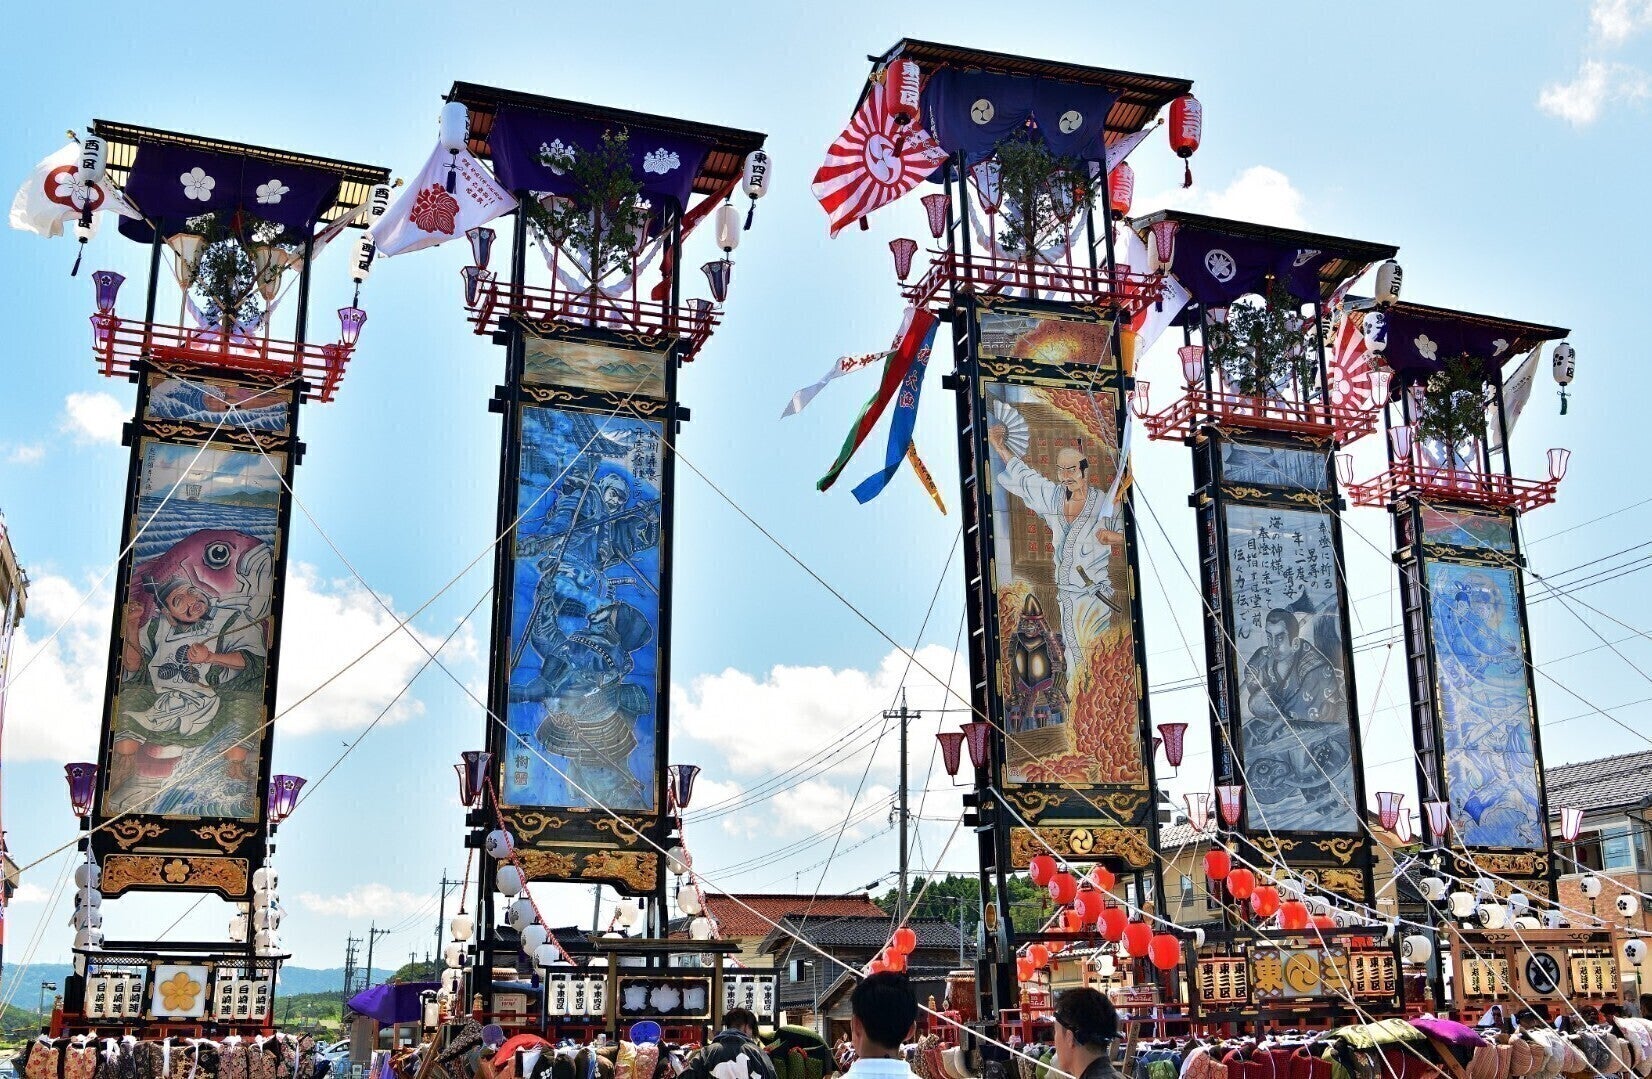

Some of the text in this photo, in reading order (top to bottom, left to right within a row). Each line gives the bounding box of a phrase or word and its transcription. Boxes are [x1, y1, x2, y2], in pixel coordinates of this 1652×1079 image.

[900, 61, 920, 109] 東三区
[82, 139, 100, 170] 西一区
[750, 152, 767, 187] 東四区
[371, 187, 390, 216] 西一区
[1268, 516, 1284, 576] 海の神様
[1292, 531, 1308, 591] 年に一度の
[1203, 963, 1215, 999] 東三区
[1219, 963, 1231, 999] 東三区
[1234, 962, 1246, 998] 東三区
[1370, 957, 1381, 991] 東三区
[1383, 956, 1396, 991] 東三区
